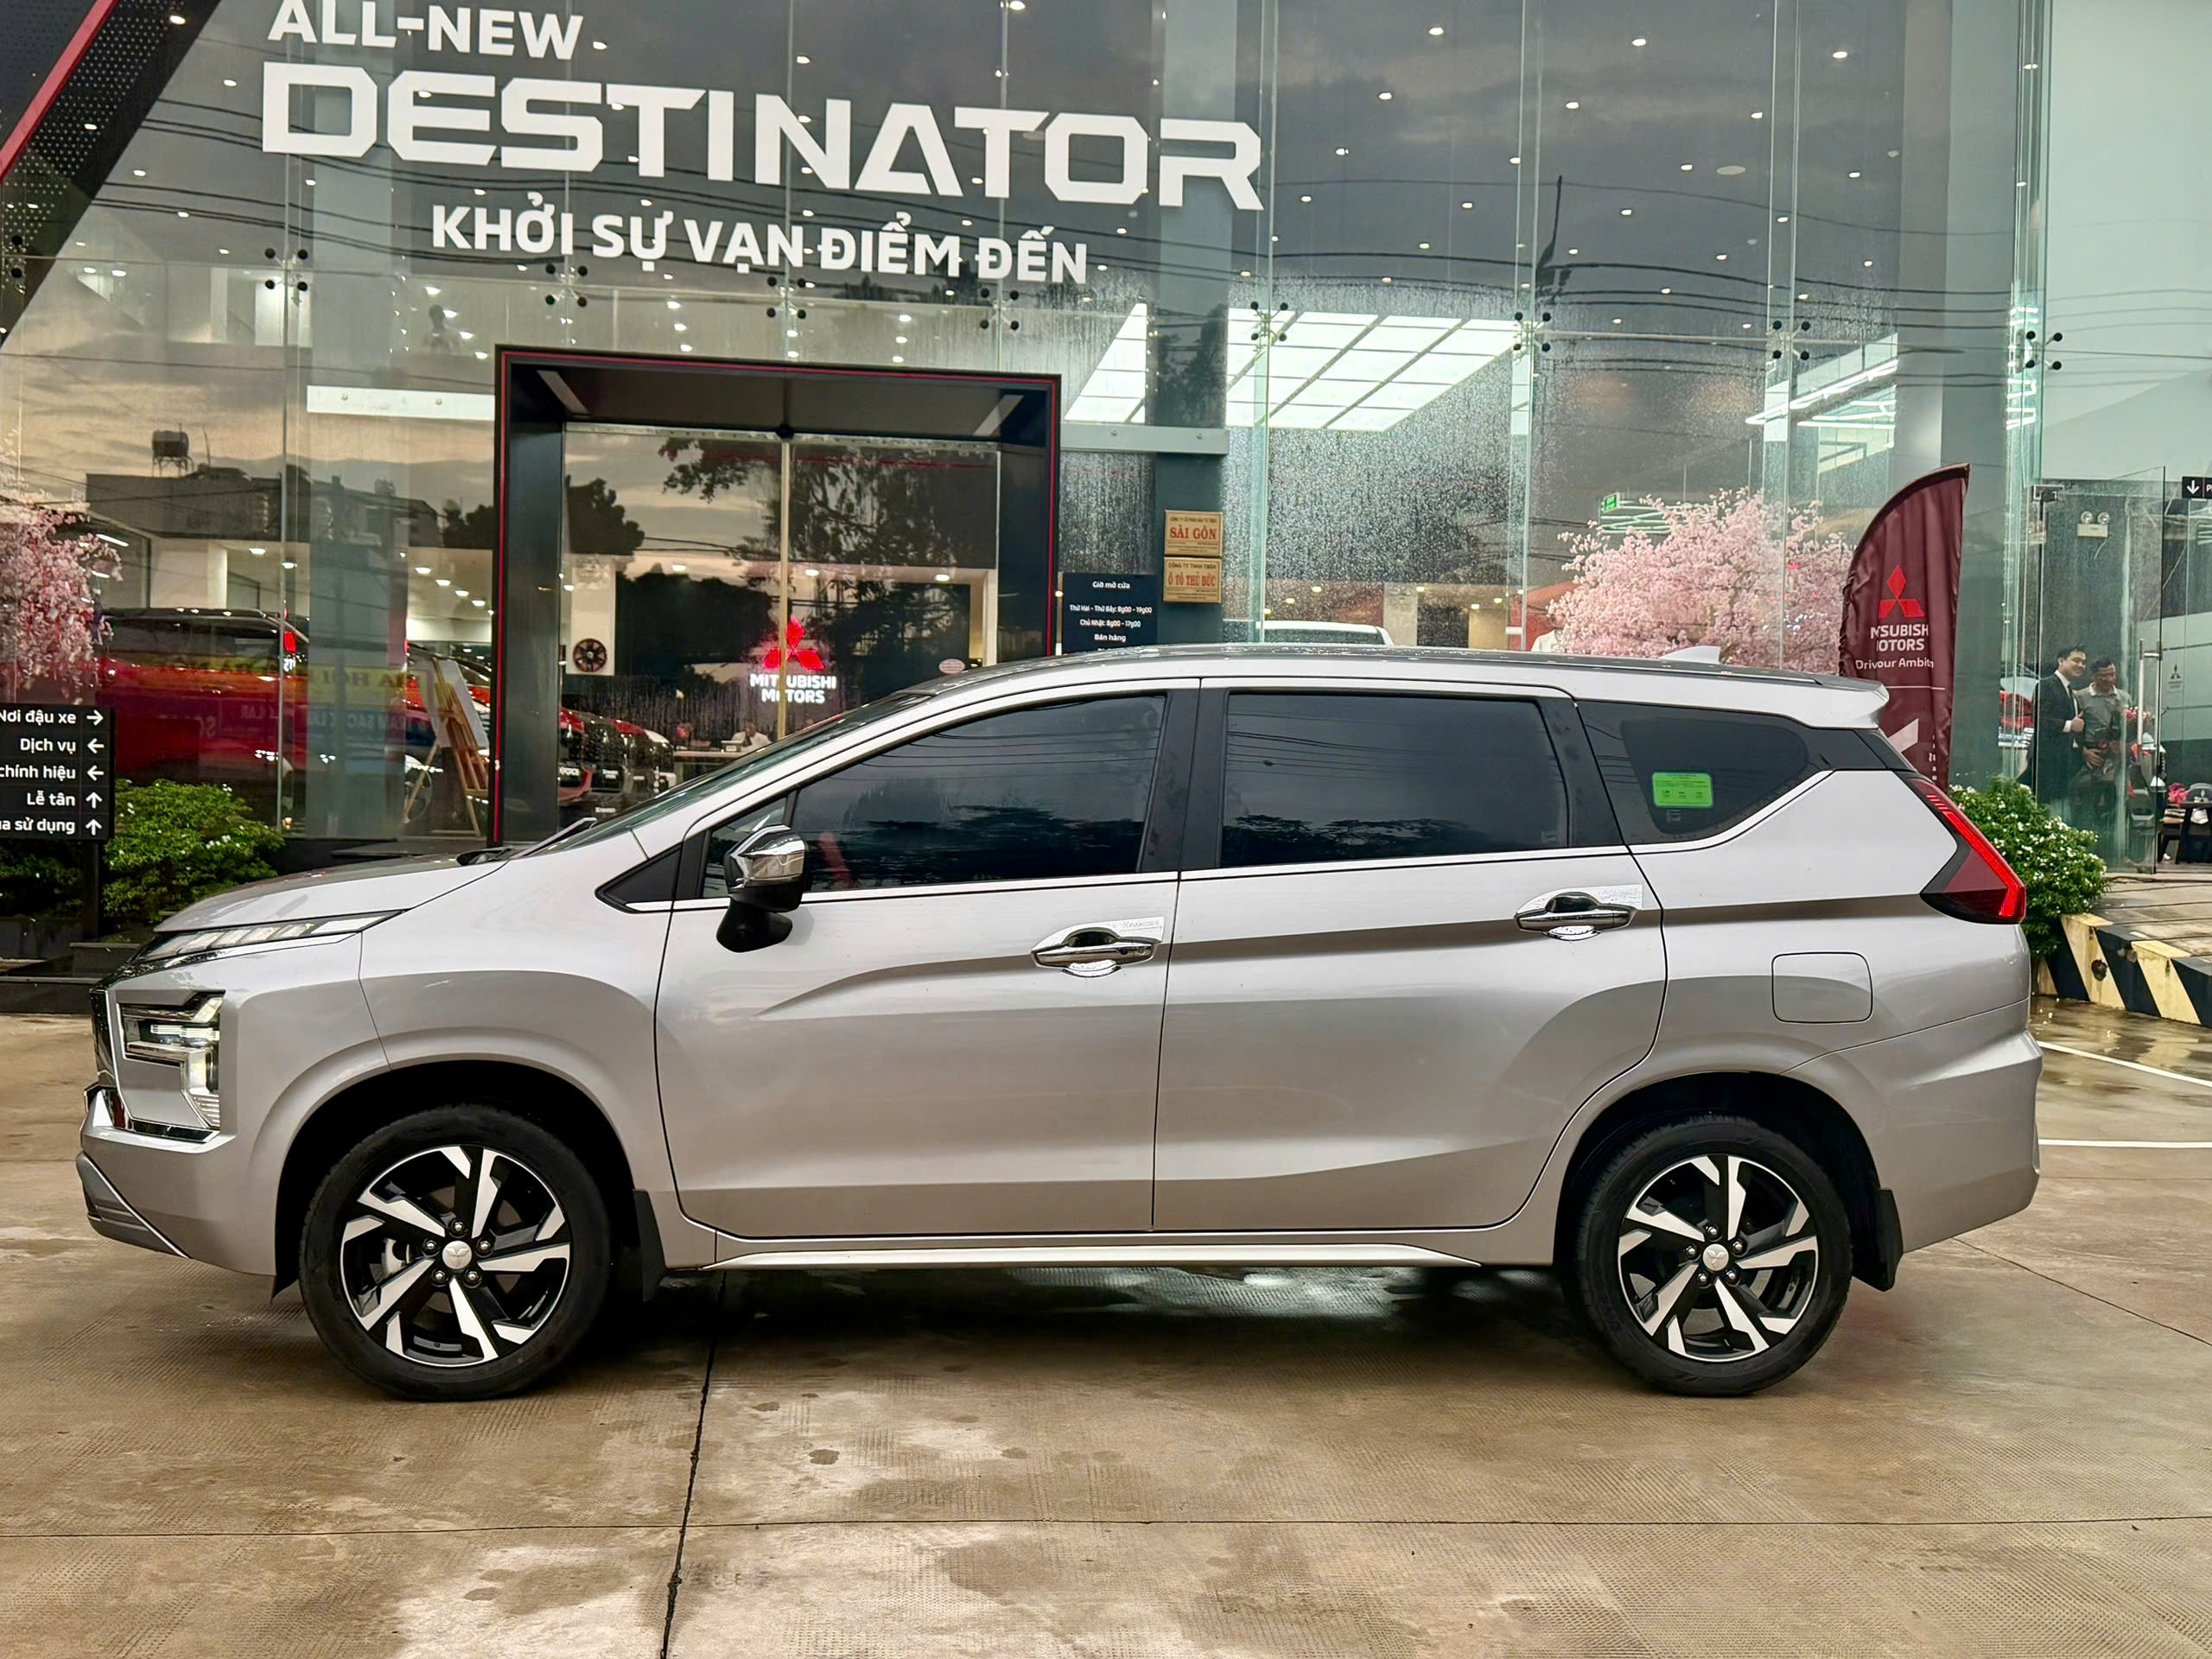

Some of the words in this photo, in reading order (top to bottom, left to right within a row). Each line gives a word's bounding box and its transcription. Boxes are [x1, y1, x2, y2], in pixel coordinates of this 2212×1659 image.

[268, 0, 583, 60] ALL-NEW
[263, 61, 1264, 211] DESTINATOR
[433, 191, 574, 255] KHỞI
[593, 212, 674, 272] SỰ
[684, 219, 804, 275] VẠN
[817, 213, 963, 277] ĐIỂM
[976, 226, 1087, 284] ĐẾN
[1170, 524, 1189, 539] SÀI
[1193, 524, 1217, 540] GÒN
[1877, 639, 1924, 652] OTORS
[750, 673, 836, 690] MITUBISHI
[0, 709, 22, 722] Nơi
[25, 709, 54, 726] đậu
[58, 713, 76, 724] xe
[20, 738, 53, 753] Dịch
[57, 741, 76, 754] vụ
[43, 765, 76, 782] hiệu
[27, 790, 45, 805] Lễ
[49, 793, 75, 807] tân
[15, 817, 34, 831] sử
[37, 818, 76, 835] dụng
